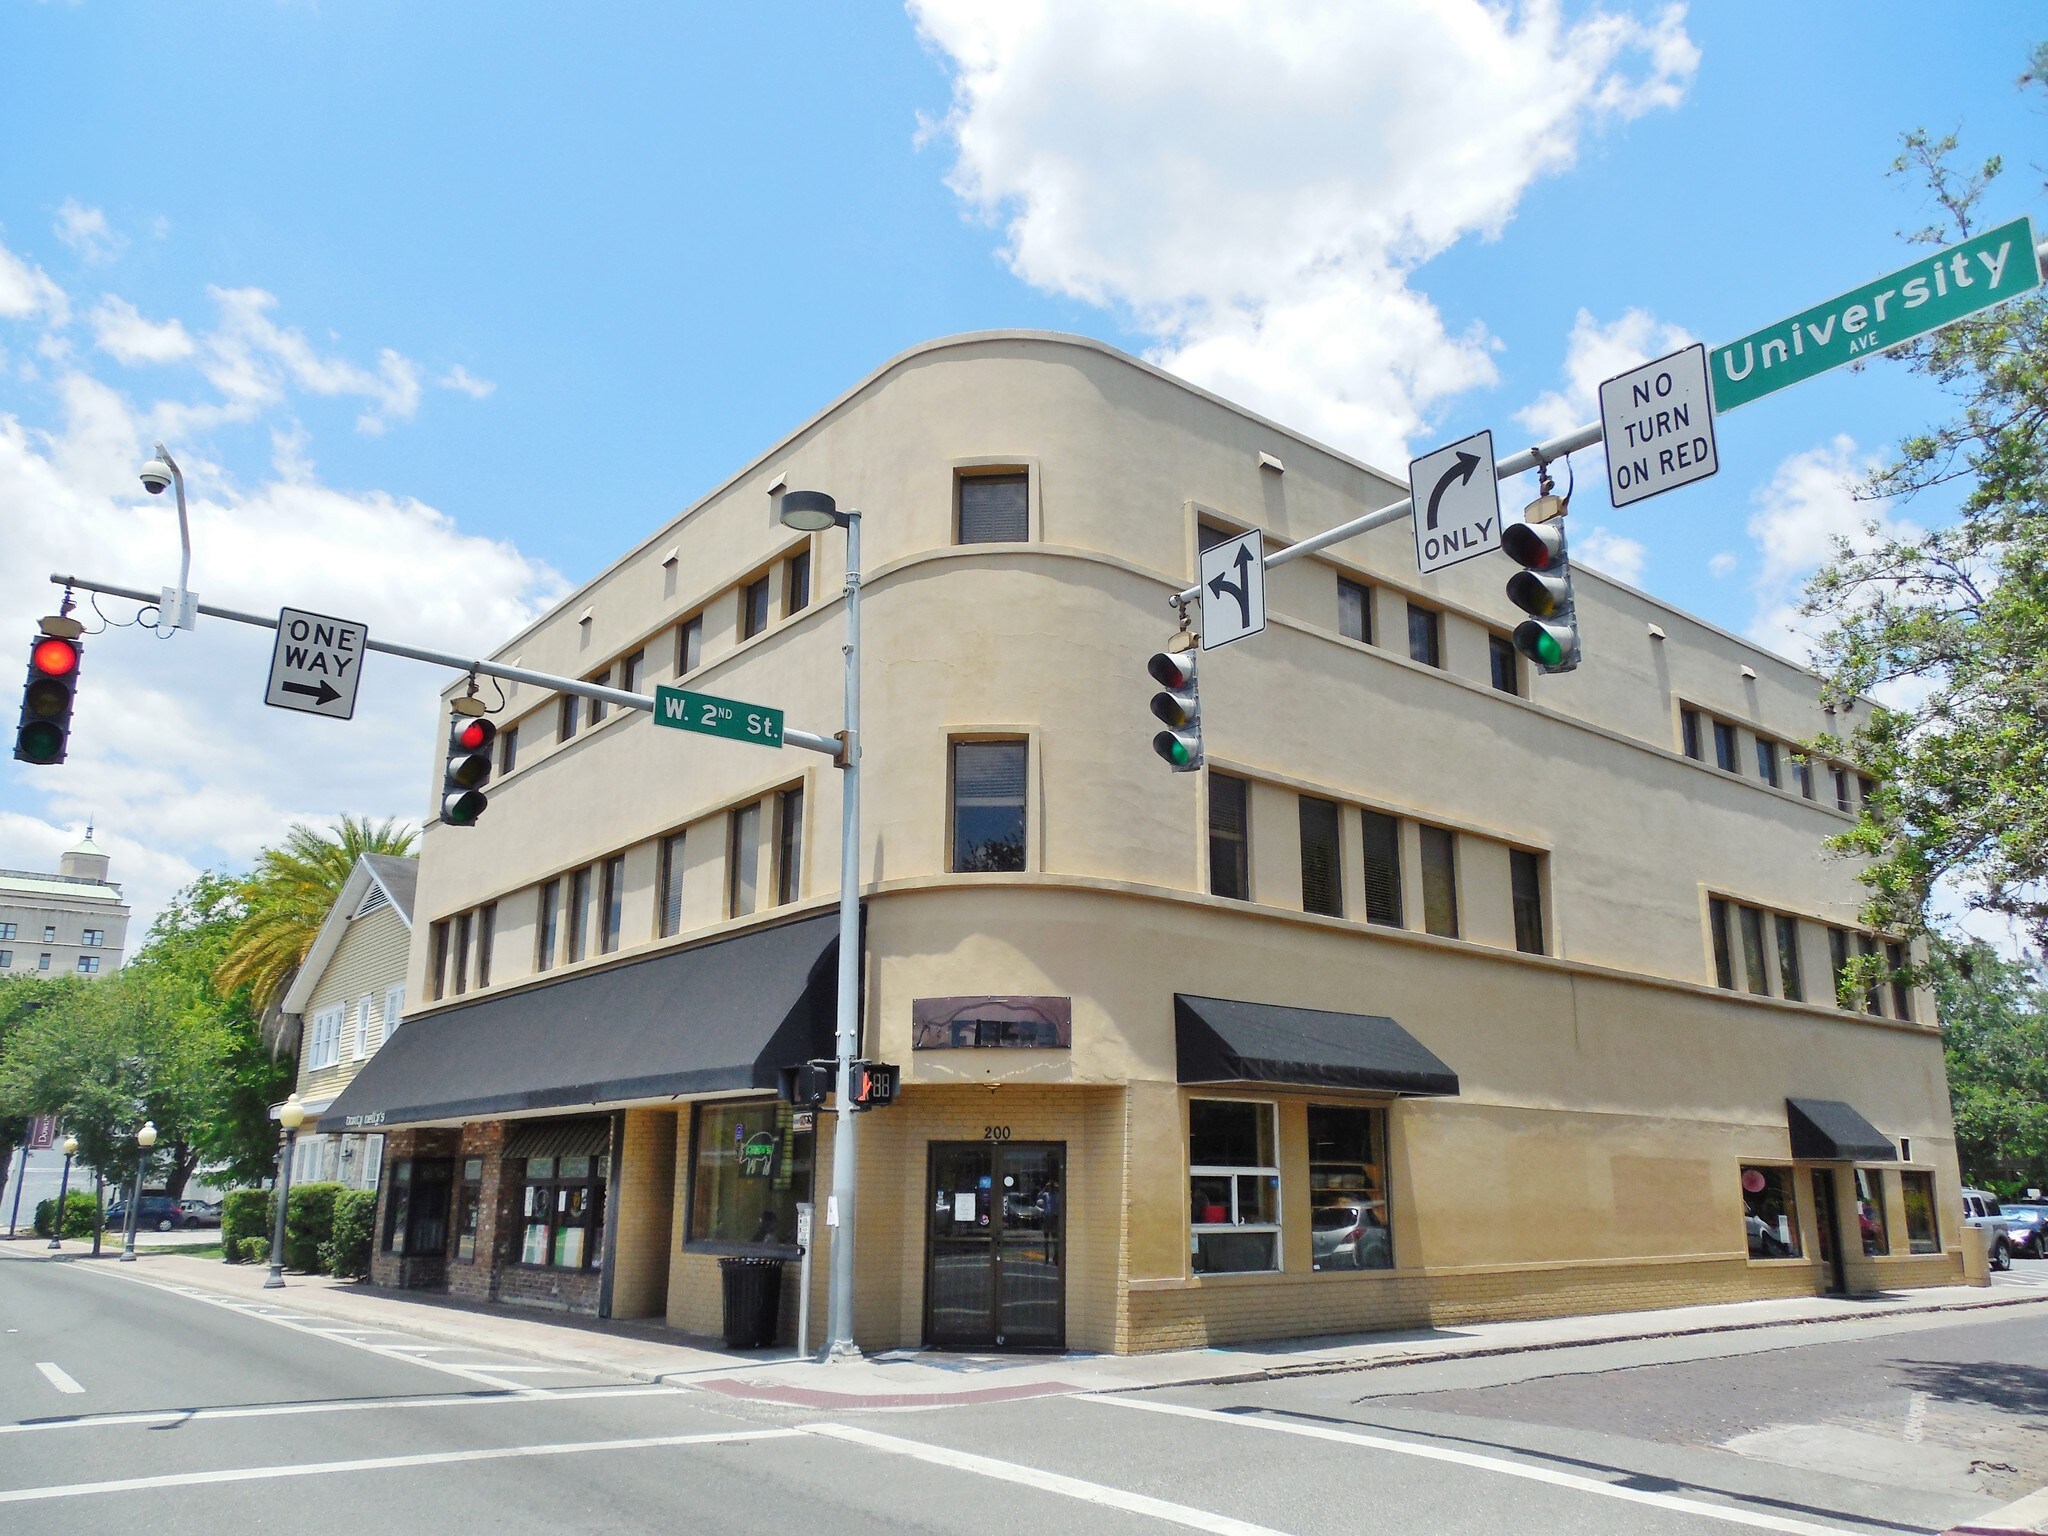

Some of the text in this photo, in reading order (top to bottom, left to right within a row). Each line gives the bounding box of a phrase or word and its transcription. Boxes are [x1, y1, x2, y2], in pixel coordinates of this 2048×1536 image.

[1724, 241, 2011, 382] University
[1849, 331, 1879, 354] AVE
[1633, 372, 1673, 408] NO
[1624, 402, 1690, 448] TURN
[1617, 436, 1708, 490] ON RED
[1424, 516, 1493, 561] ONLY
[290, 619, 356, 652] ONE
[285, 644, 354, 677] WAY
[665, 696, 779, 739] W. 2ND St.
[984, 1126, 1011, 1140] 200
